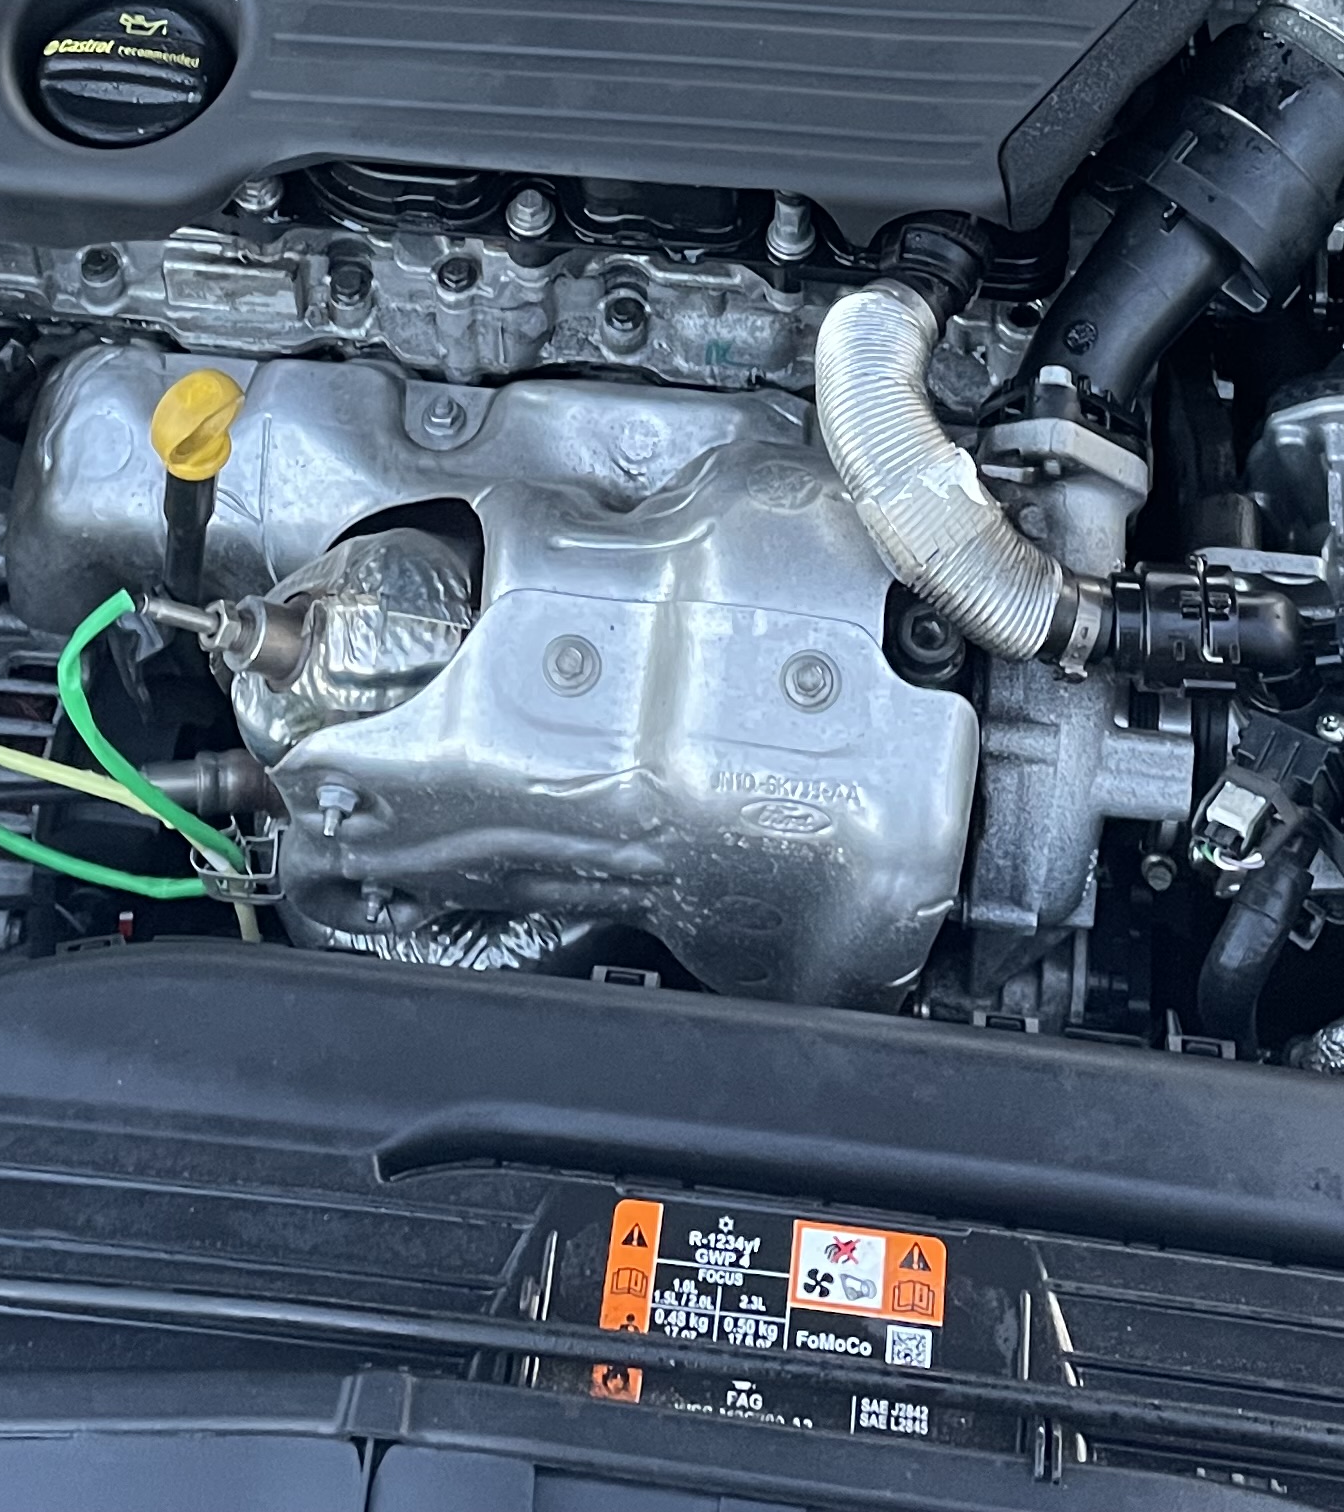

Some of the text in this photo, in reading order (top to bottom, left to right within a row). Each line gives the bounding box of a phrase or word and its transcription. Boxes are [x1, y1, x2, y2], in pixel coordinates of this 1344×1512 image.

[58, 39, 199, 69] Castrol recommended
[688, 1230, 761, 1255] R-1234yf
[695, 1248, 736, 1266] GWP
[673, 1278, 698, 1295] 1.0L
[698, 1268, 743, 1286] FOCUS
[689, 1312, 709, 1333] kg
[723, 1317, 778, 1342] 0.50 kg
[796, 1330, 873, 1357] FoMoCo
[726, 1390, 763, 1410] PAG
[861, 1397, 889, 1415] SAE
[859, 1412, 887, 1430] SAE
